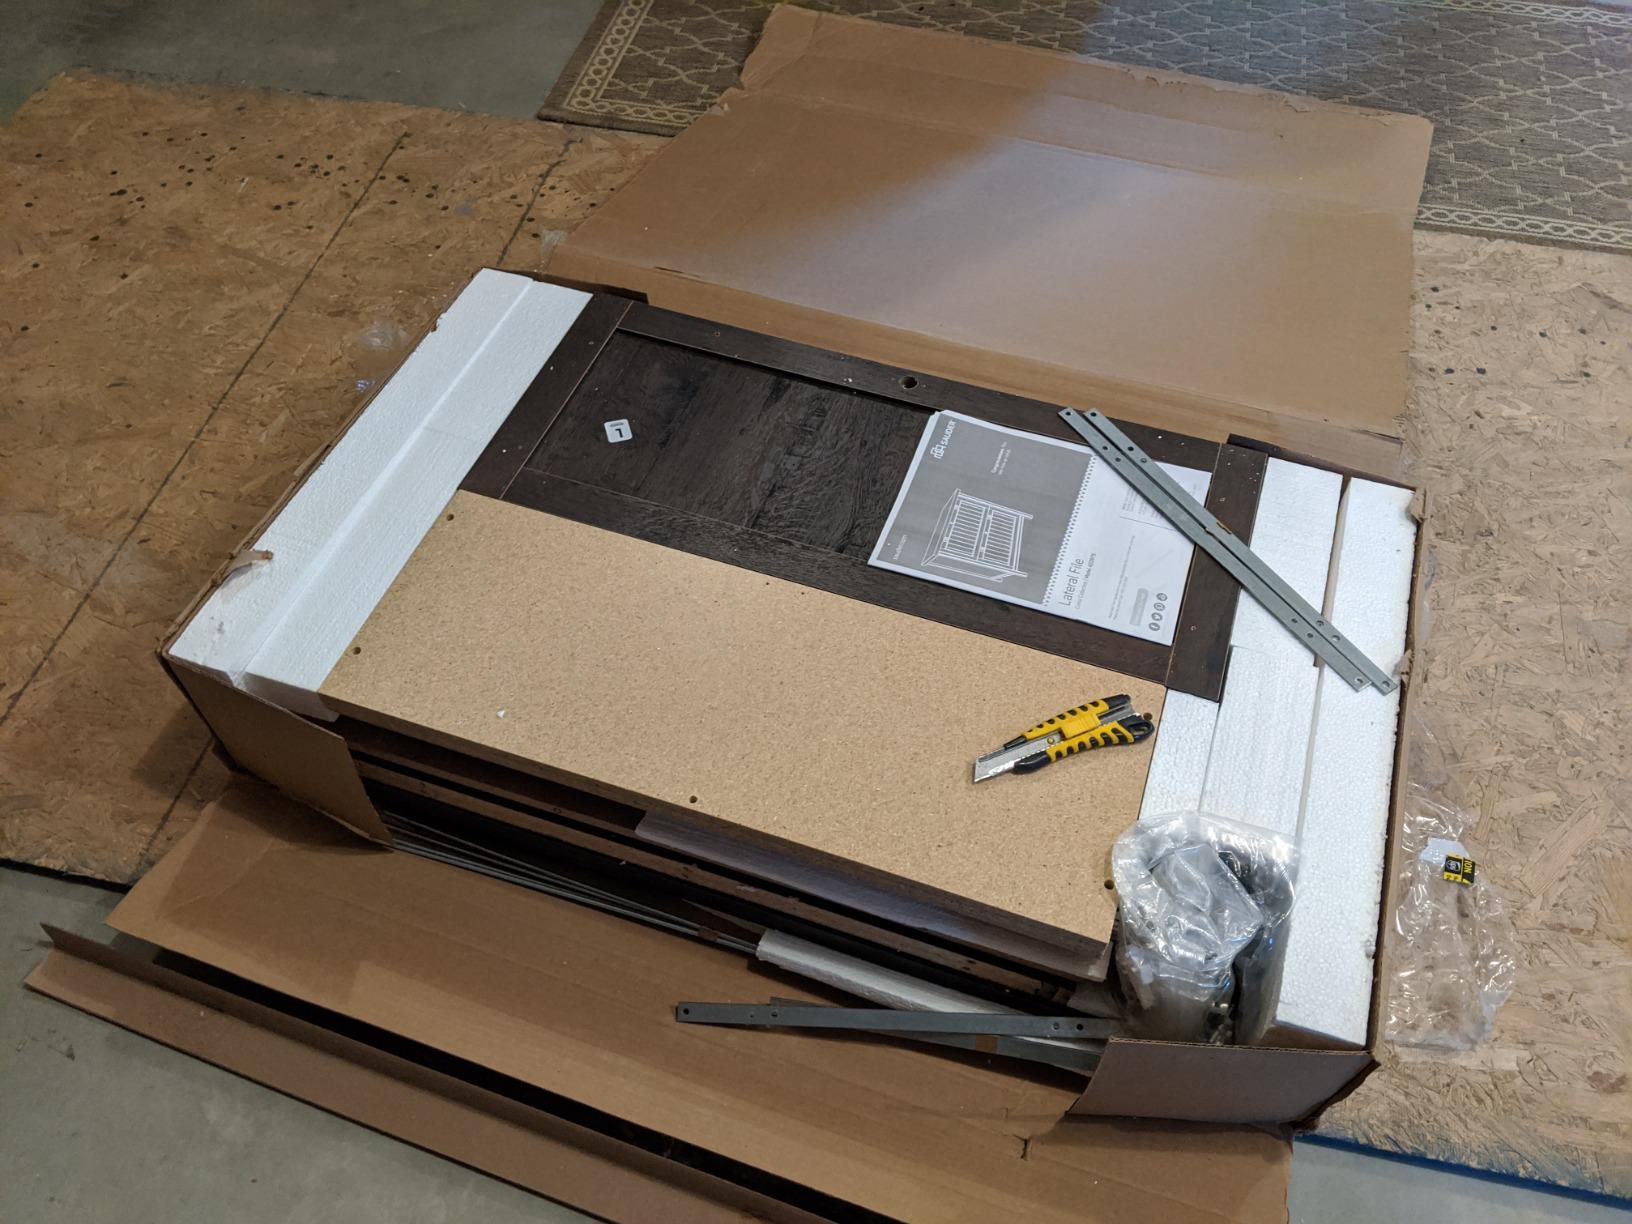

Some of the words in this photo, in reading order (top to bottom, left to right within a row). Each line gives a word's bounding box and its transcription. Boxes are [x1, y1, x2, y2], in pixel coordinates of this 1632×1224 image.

[940, 420, 957, 446] SAUDER
[1057, 574, 1081, 606] Lateral
[1069, 558, 1085, 575] File
